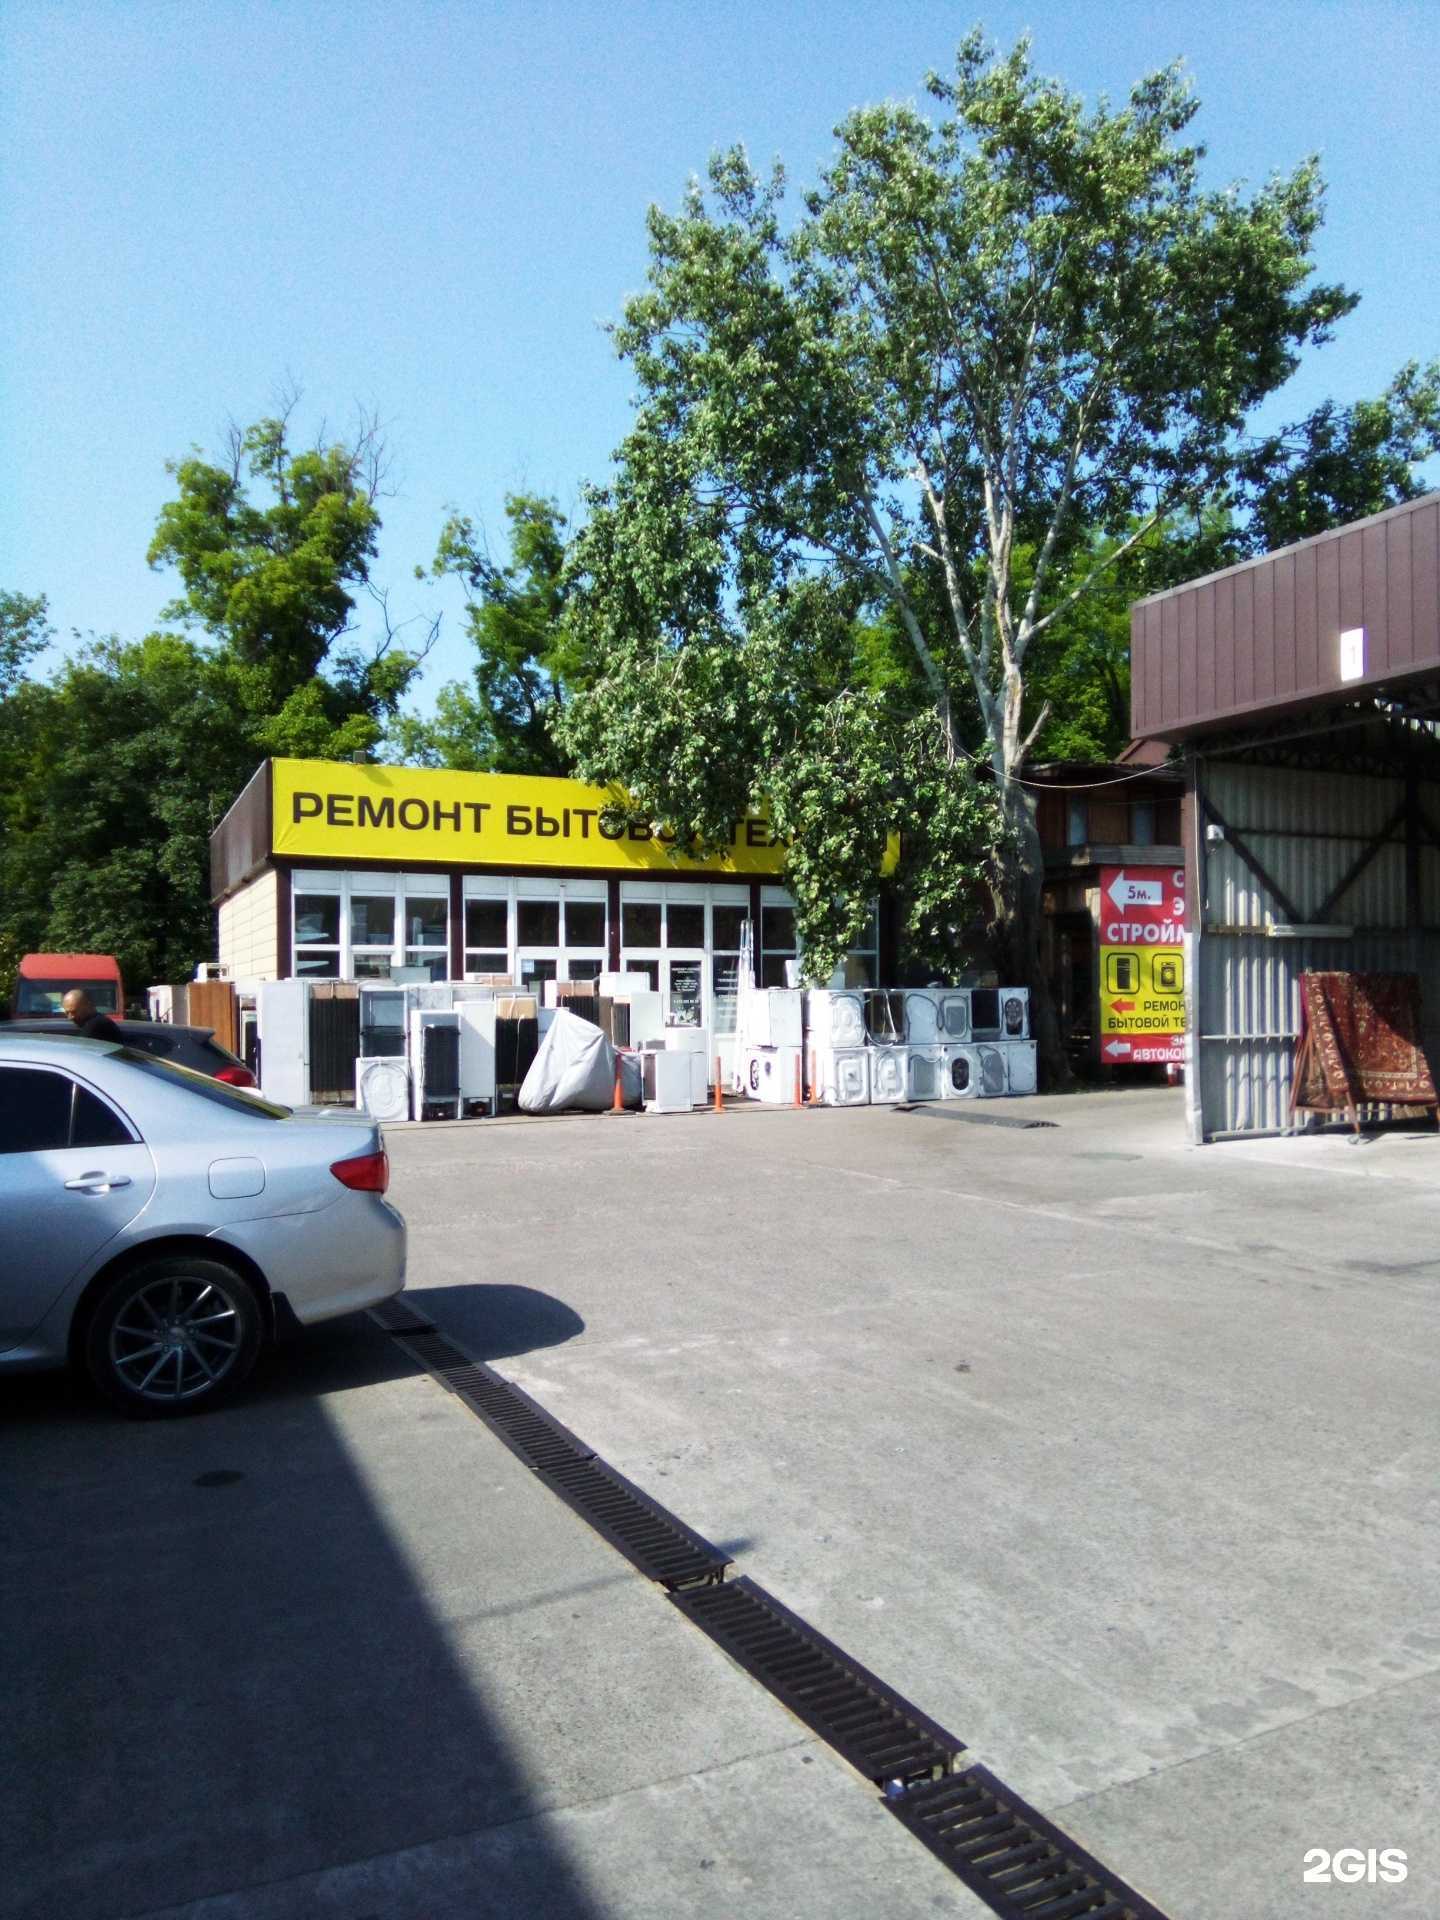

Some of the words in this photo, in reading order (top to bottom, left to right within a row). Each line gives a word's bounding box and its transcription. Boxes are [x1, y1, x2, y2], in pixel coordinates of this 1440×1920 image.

[293, 791, 491, 833] РЕМОНТ
[506, 805, 706, 843] БЫТОВО
[1172, 870, 1184, 888] С
[1172, 897, 1185, 916] Э
[1143, 1000, 1186, 1012] РЕМОН
[1108, 1014, 1169, 1029] БЫТОВОЙ
[1173, 1016, 1186, 1028] ТЕ
[1133, 1047, 1185, 1061] АВТОКО
